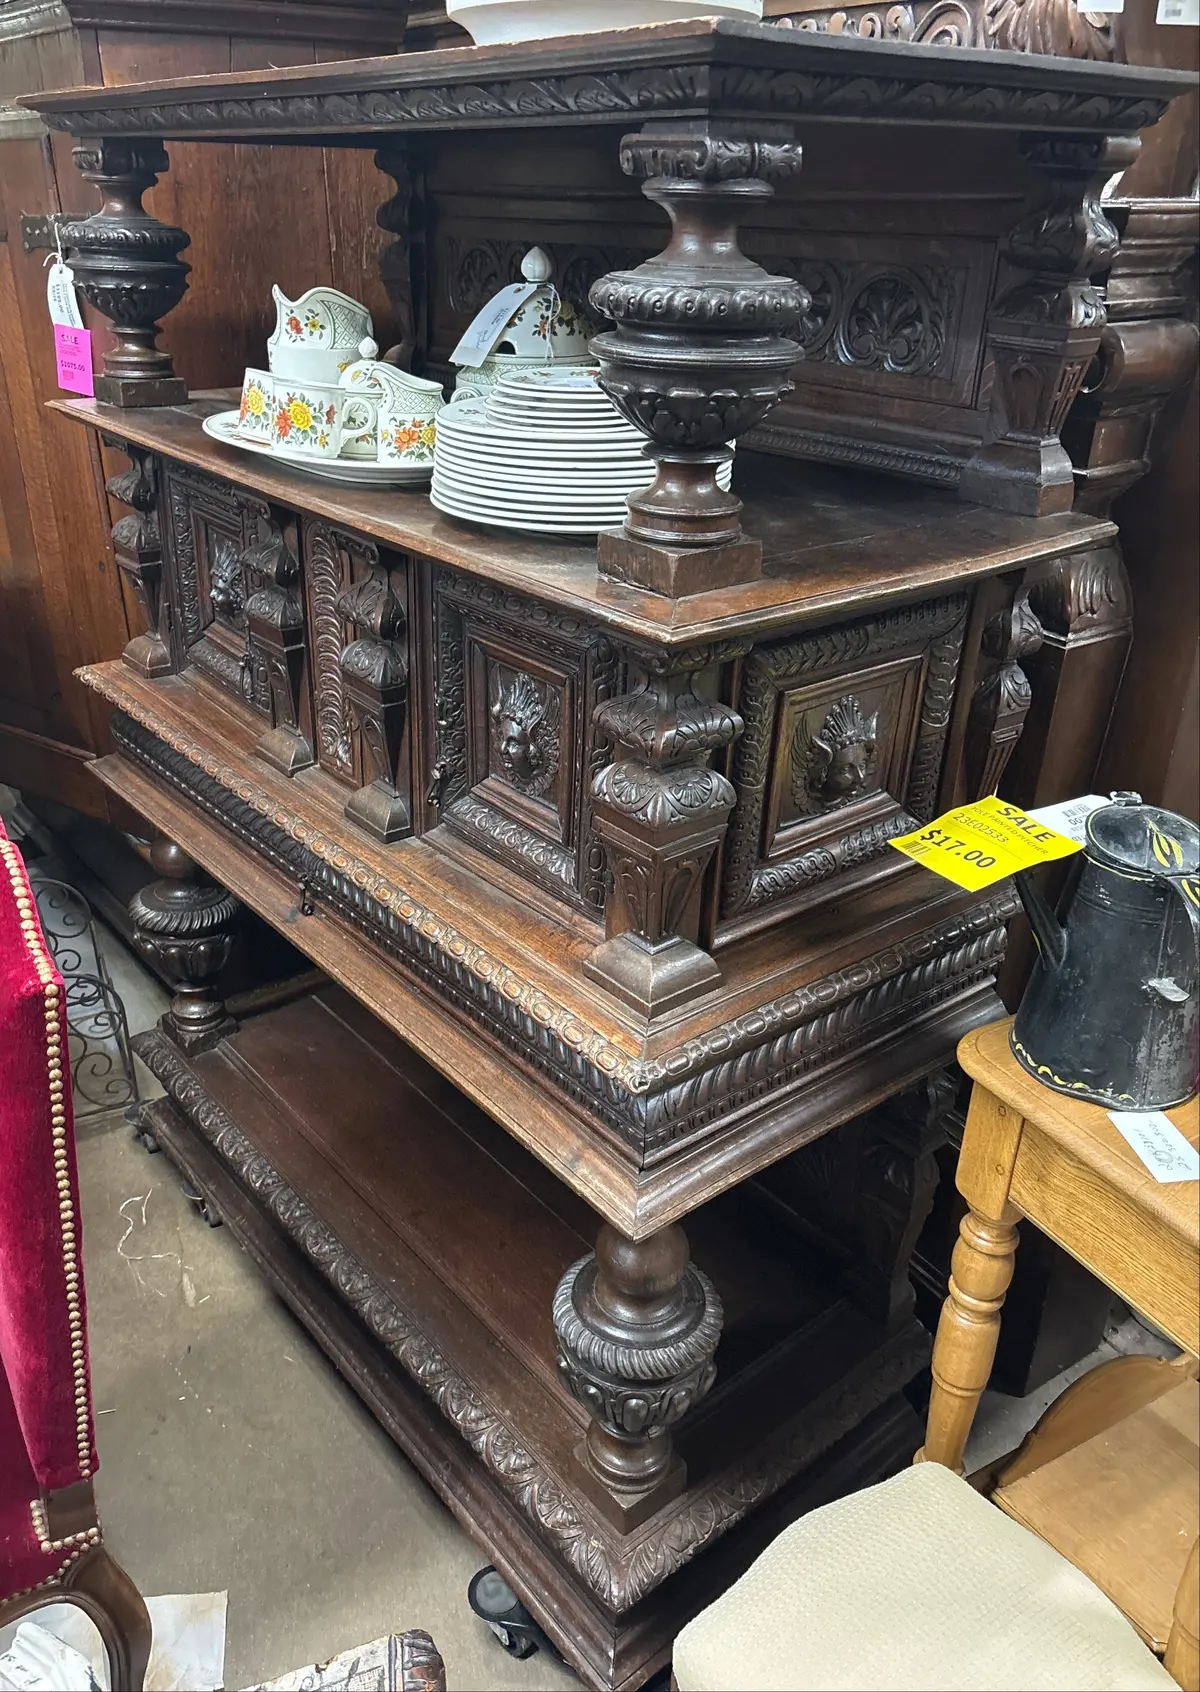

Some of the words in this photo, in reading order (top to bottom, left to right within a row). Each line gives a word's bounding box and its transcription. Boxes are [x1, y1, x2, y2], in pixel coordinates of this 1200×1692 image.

[61, 333, 79, 345] SALE
[61, 360, 85, 372] $1075.00
[953, 812, 1009, 843] 23E02533
[971, 806, 989, 817] TOLE
[988, 814, 1017, 835] PAINTED
[1018, 833, 1048, 854] PITCHER
[996, 807, 1056, 843] SALE
[919, 829, 996, 869] $17.00
